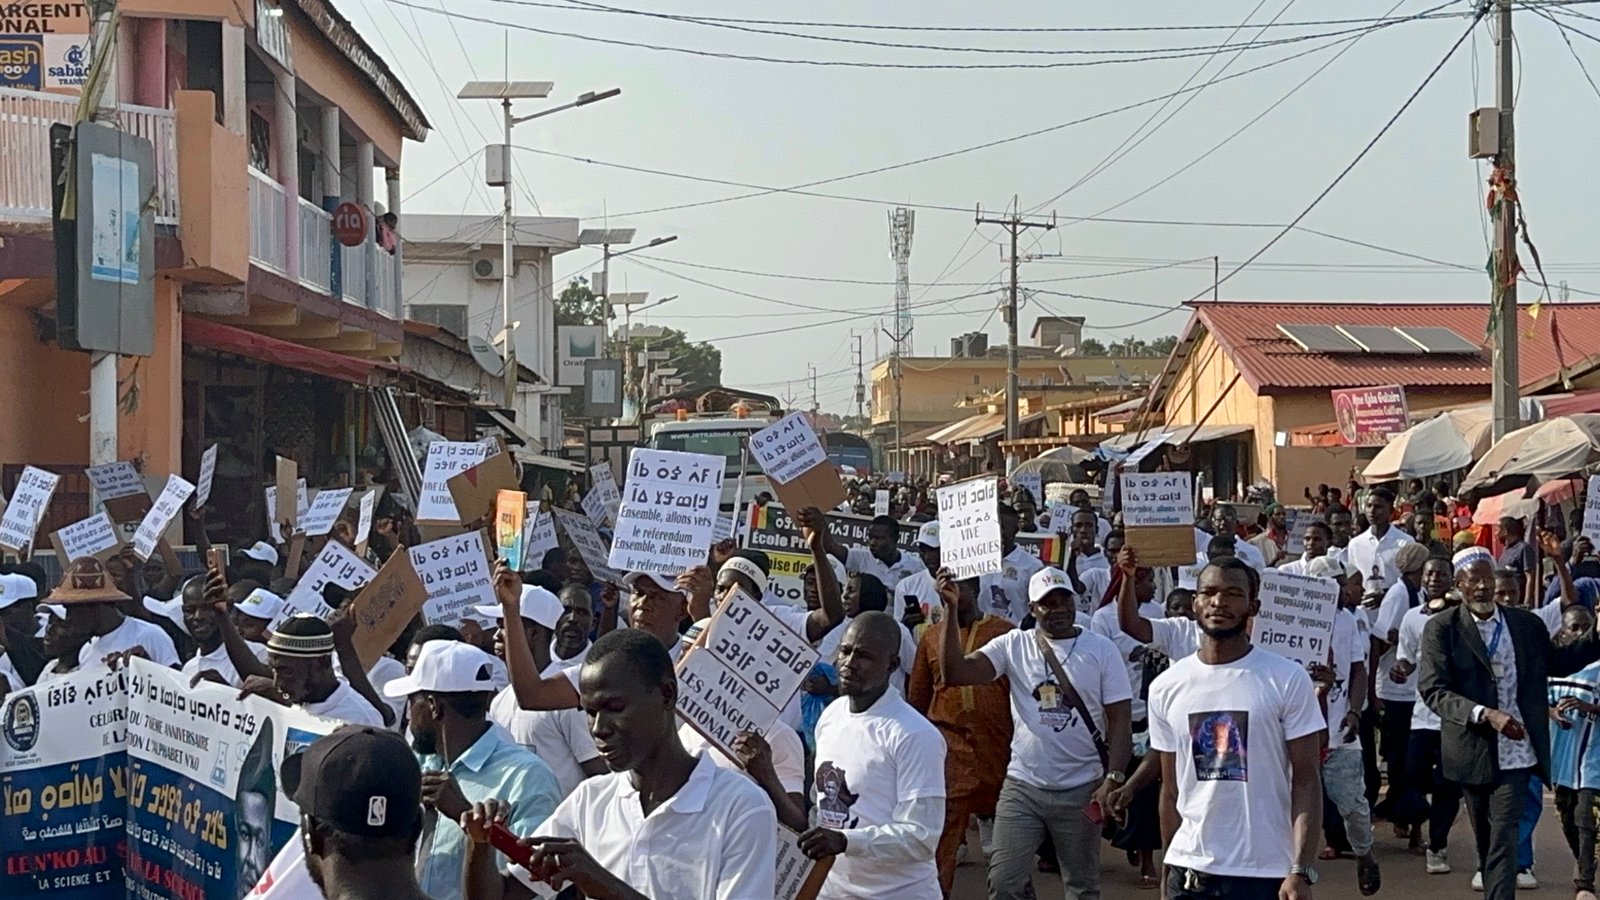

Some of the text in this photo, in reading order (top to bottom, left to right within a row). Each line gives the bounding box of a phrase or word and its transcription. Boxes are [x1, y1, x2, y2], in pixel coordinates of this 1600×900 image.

[0, 19, 55, 33] NAL
[336, 206, 361, 229] ria
[620, 505, 712, 528] Ensemble, allons vers
[632, 525, 641, 537] le
[752, 530, 788, 547] École
[961, 526, 980, 541] VIVE
[660, 543, 685, 557] allons
[688, 546, 706, 559] vers
[942, 540, 1000, 563] LES LANGUES
[626, 556, 634, 570] le
[950, 559, 998, 579] ATIONALES
[718, 670, 750, 703] VIVE
[678, 666, 764, 737] LES LANGUES
[129, 710, 143, 725] DU
[7, 855, 31, 875] LE
[54, 873, 91, 888] SCIENCE
[96, 870, 112, 882] ET
